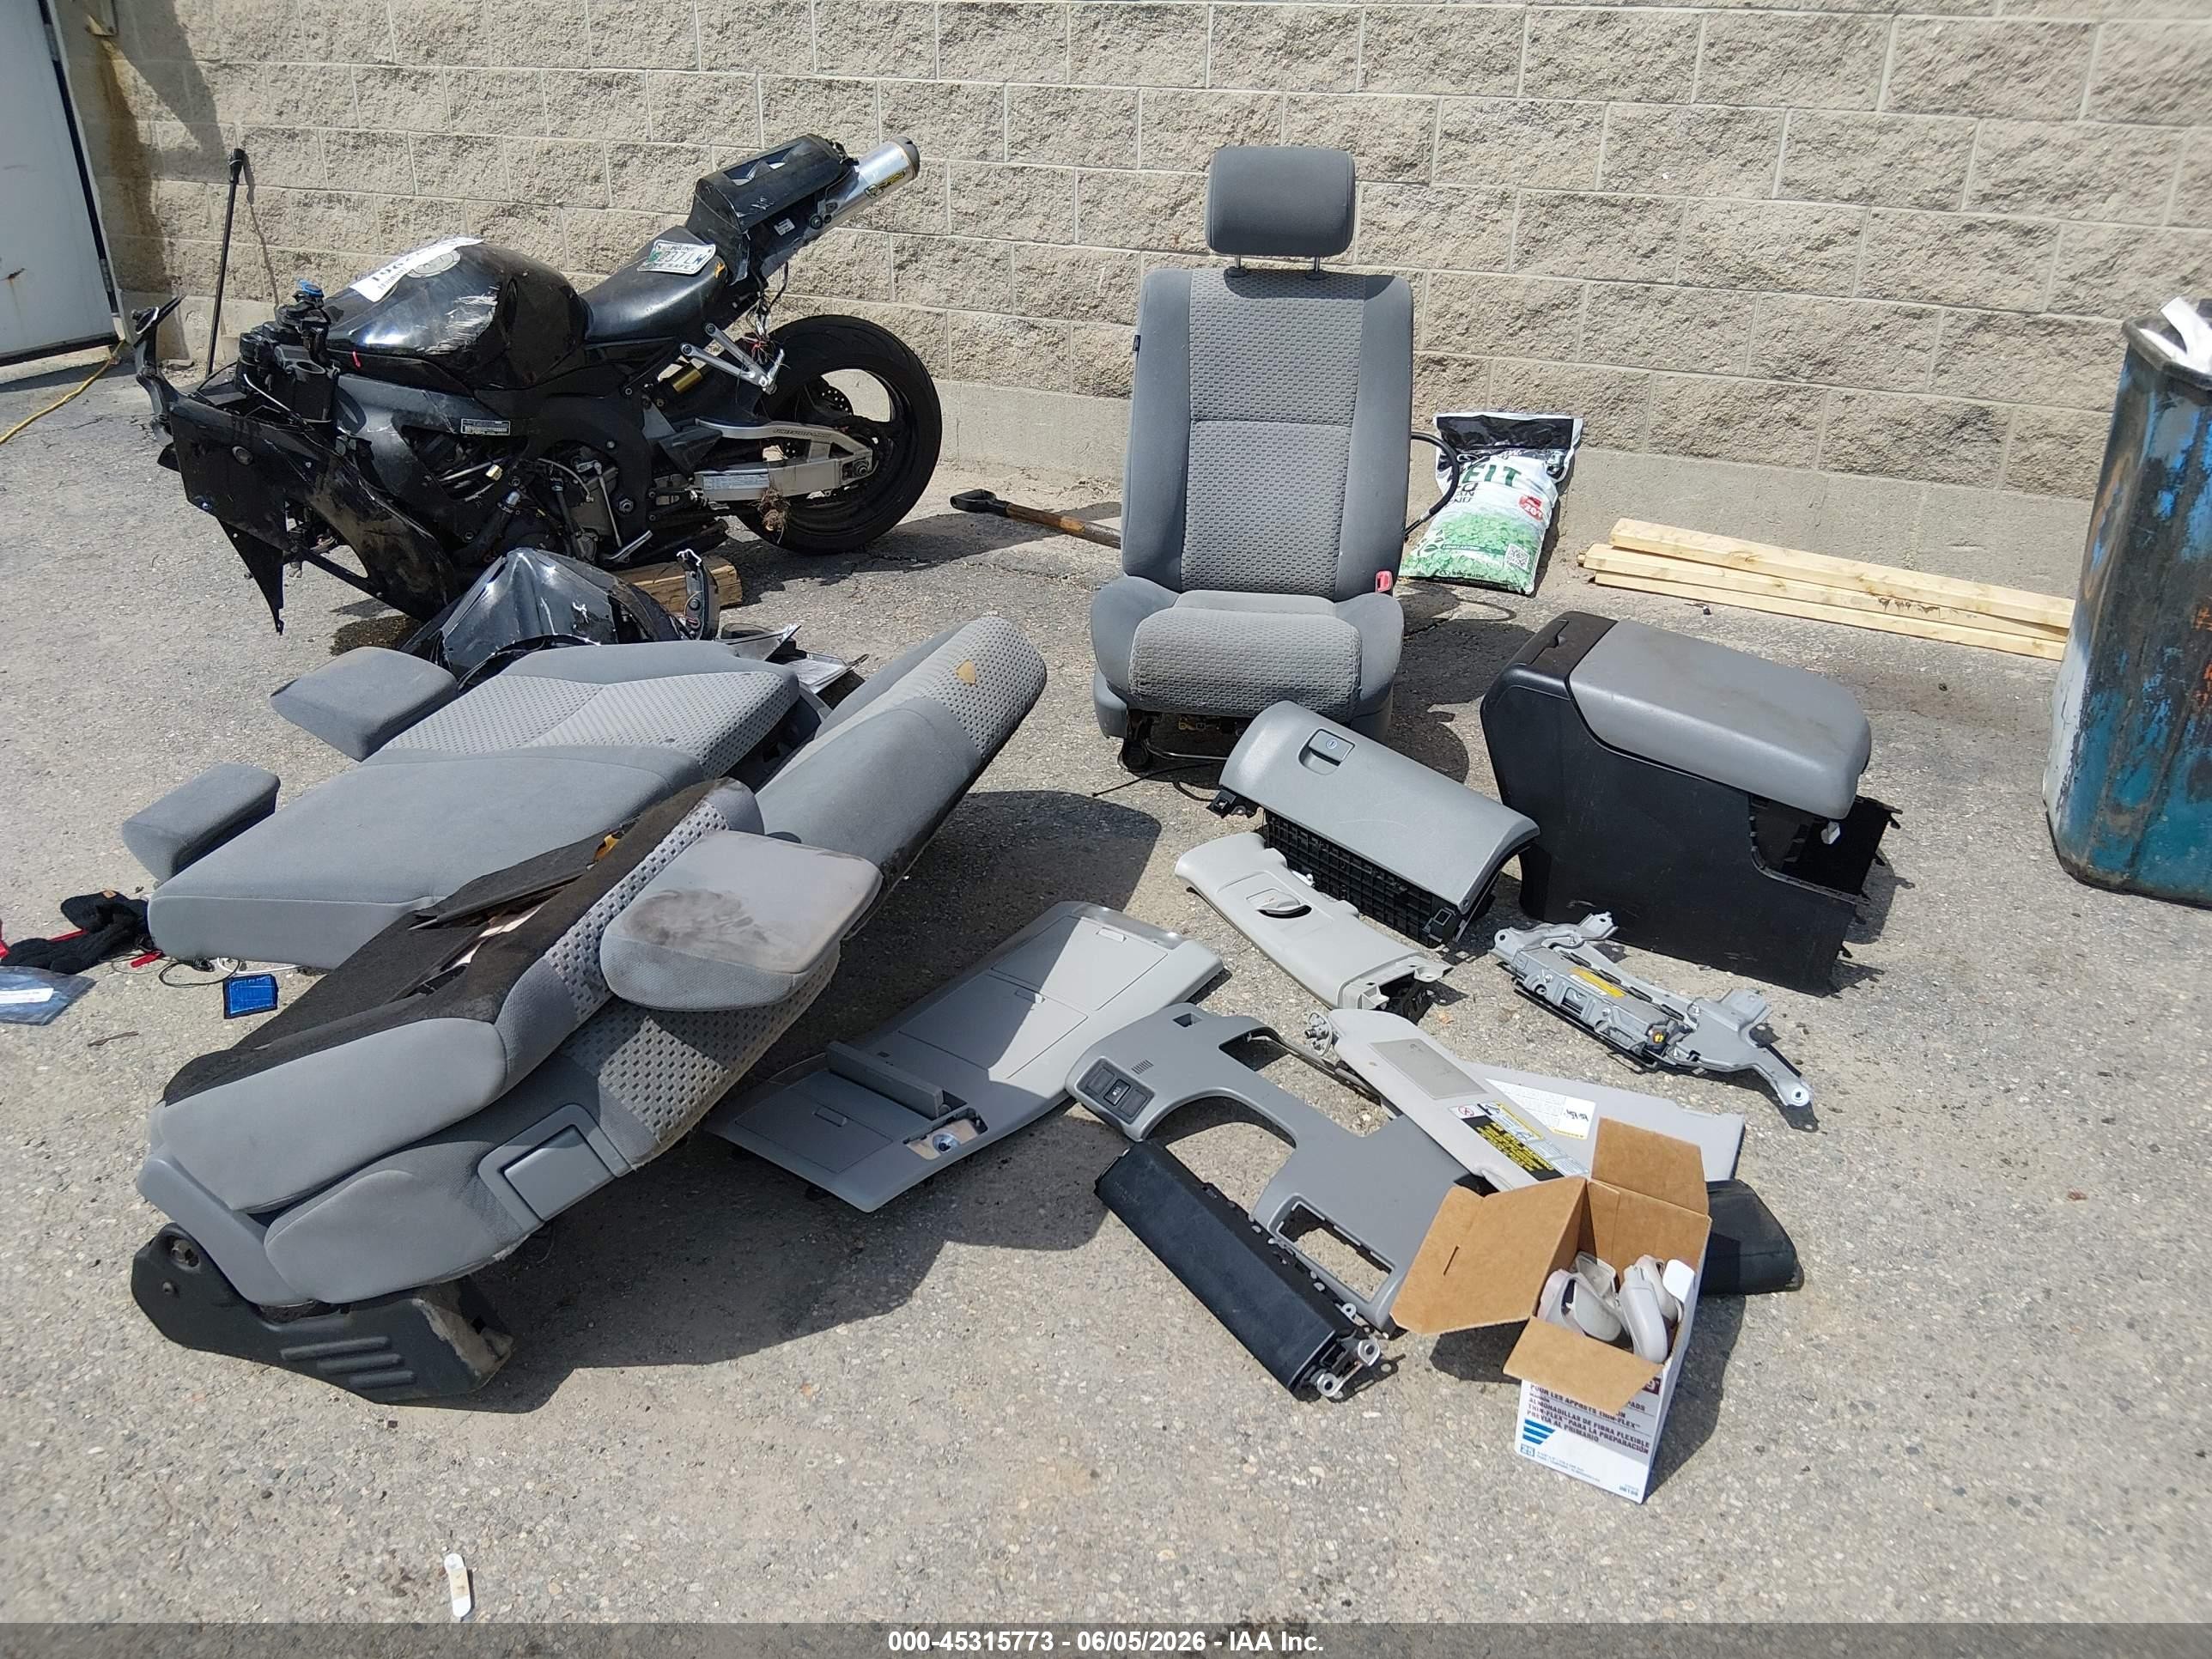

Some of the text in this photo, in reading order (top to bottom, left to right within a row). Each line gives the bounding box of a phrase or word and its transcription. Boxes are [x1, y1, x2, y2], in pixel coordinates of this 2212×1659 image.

[1568, 1419, 1587, 1431] PARA
[1583, 1418, 1593, 1426] DE
[1593, 1422, 1615, 1435] FIBRA
[1616, 1431, 1650, 1449] FLEXIBLE
